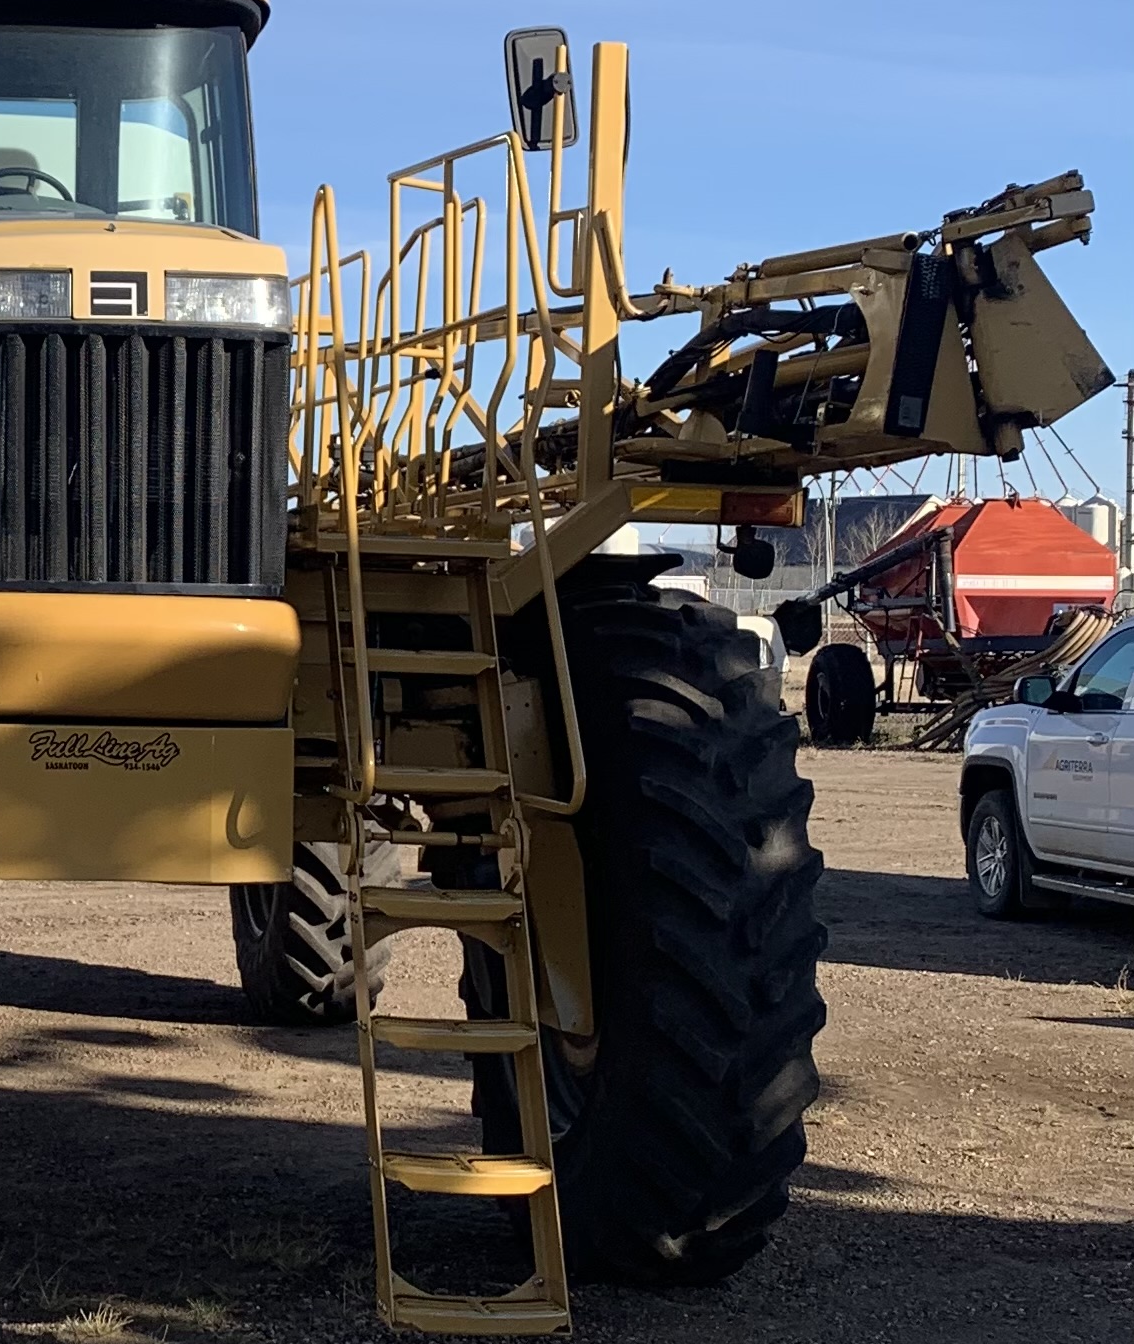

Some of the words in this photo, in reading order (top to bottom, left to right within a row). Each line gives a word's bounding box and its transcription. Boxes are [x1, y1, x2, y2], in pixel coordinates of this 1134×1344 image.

[29, 730, 88, 761] Full
[83, 731, 141, 766] Line
[135, 733, 180, 767] Ag
[45, 761, 89, 770] SASKATOON
[1055, 759, 1094, 773] AGRITERRA
